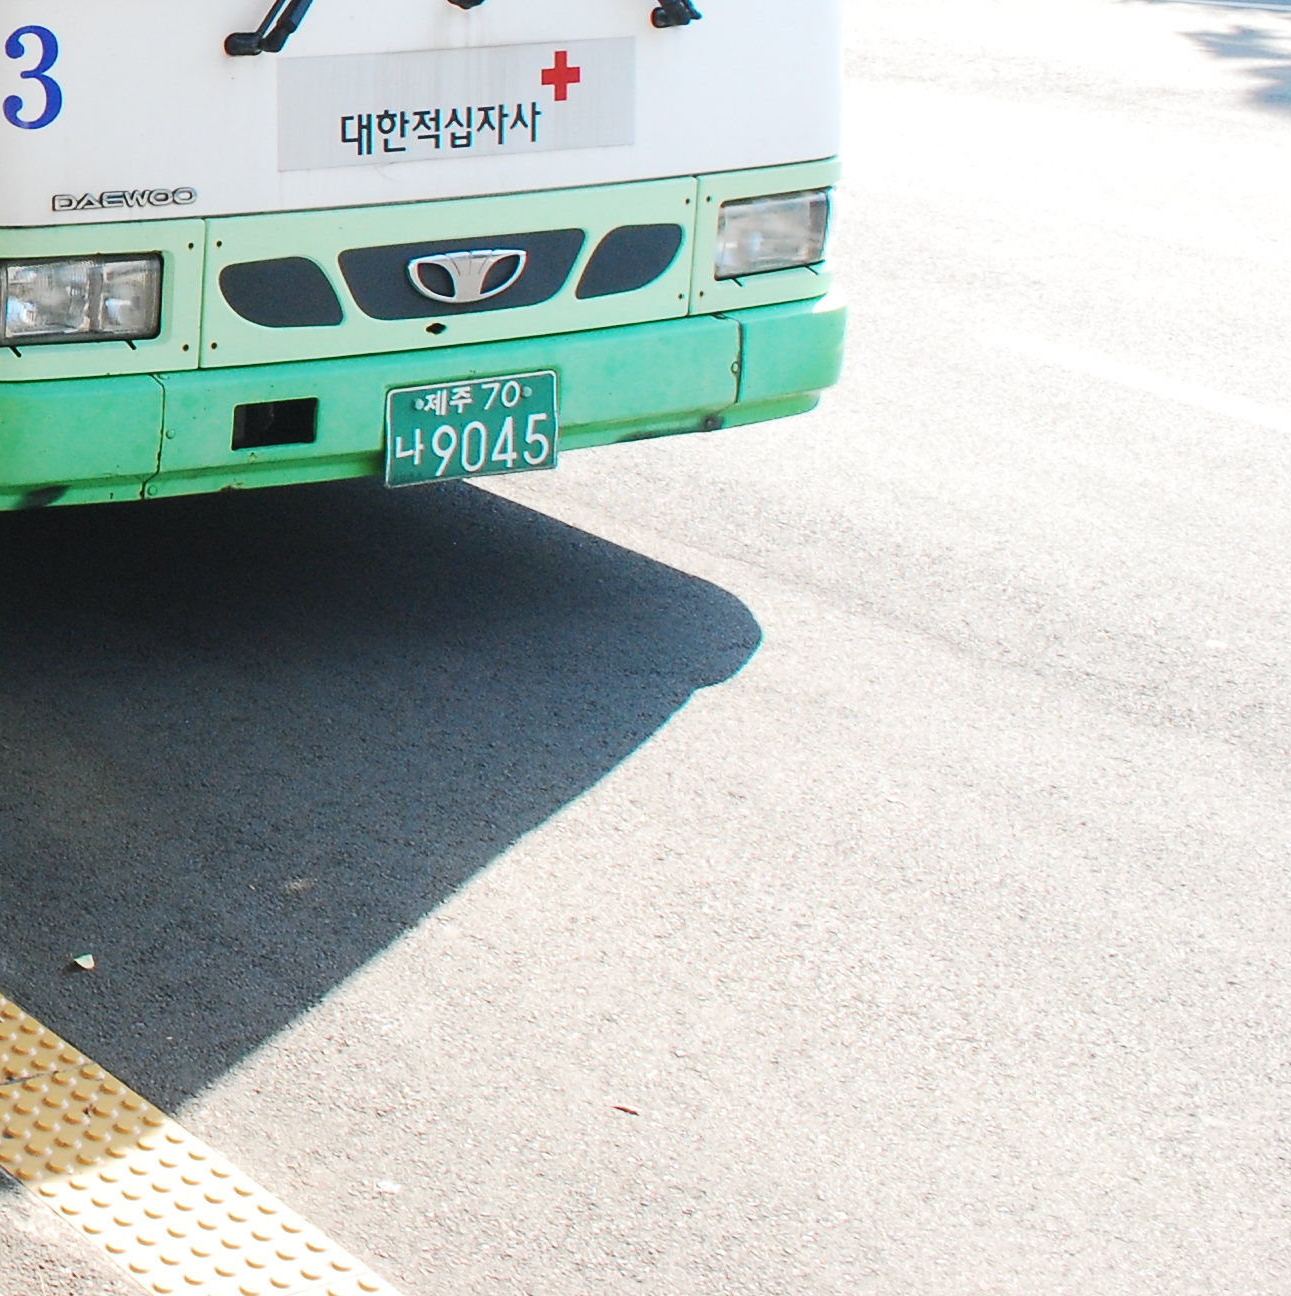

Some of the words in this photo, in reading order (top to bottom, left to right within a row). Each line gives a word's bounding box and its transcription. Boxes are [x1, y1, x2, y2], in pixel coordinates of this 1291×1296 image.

[3, 25, 63, 130] 3
[340, 101, 543, 156] 대한적십자사
[52, 186, 198, 212] DAEWOO
[422, 386, 474, 417] 제주
[481, 380, 521, 411] 70
